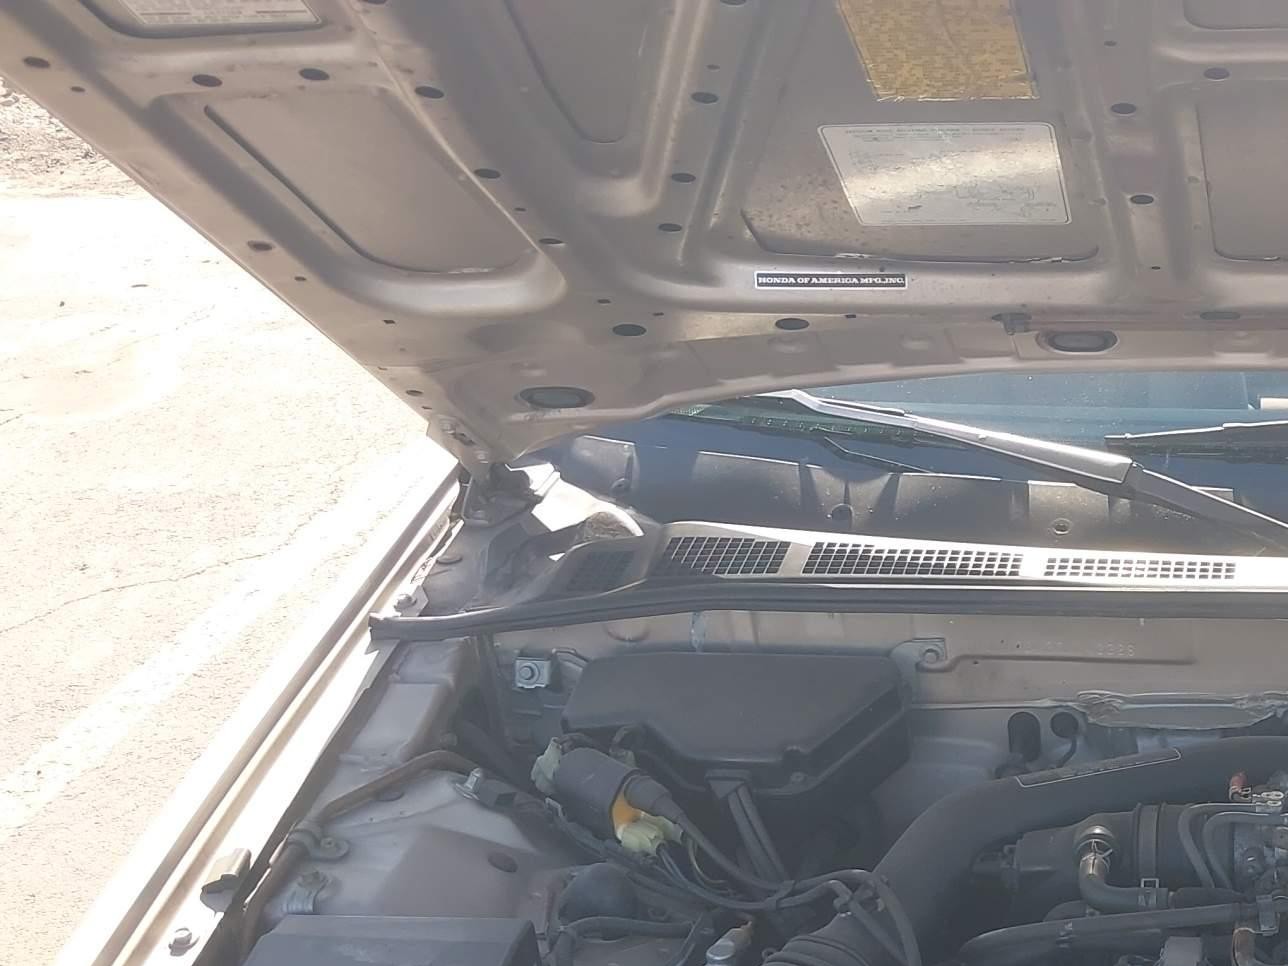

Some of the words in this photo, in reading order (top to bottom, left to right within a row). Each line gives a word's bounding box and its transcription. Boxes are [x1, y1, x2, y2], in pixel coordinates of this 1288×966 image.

[758, 276, 796, 284] HONDA
[797, 276, 809, 284] OF
[810, 276, 860, 284] AMERICA
